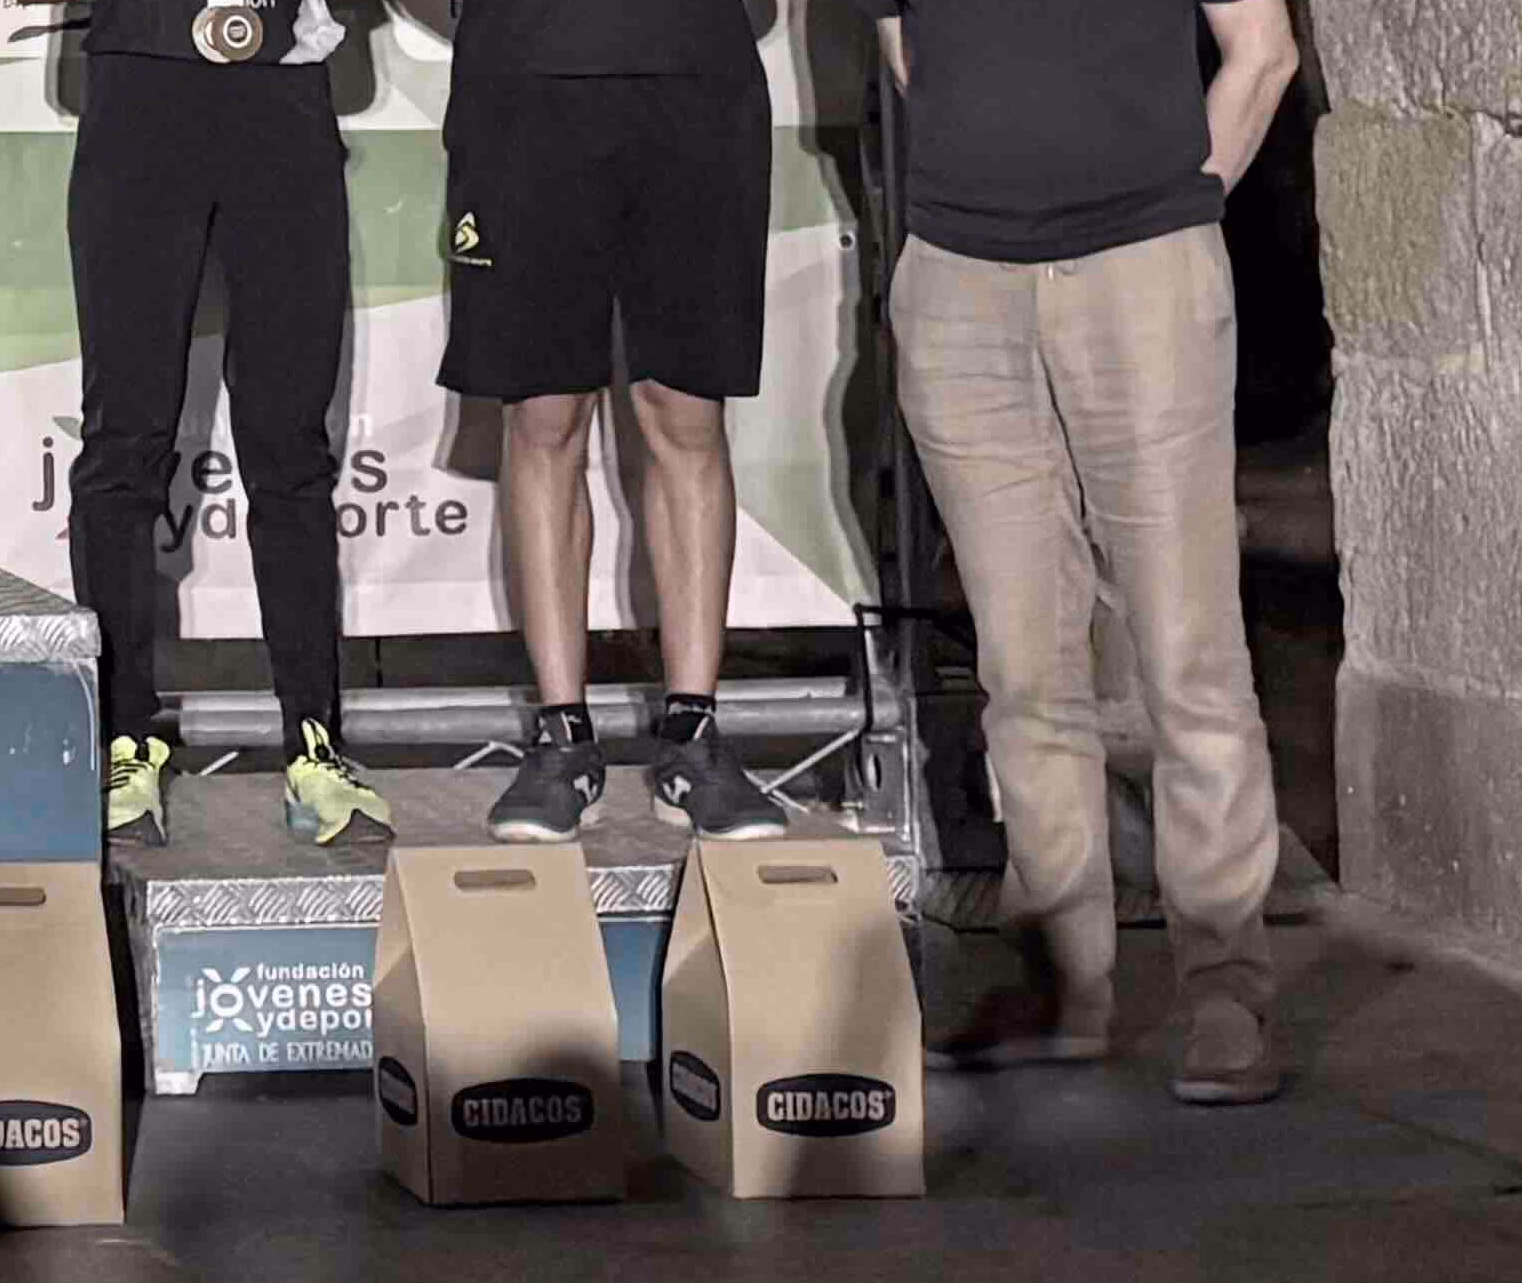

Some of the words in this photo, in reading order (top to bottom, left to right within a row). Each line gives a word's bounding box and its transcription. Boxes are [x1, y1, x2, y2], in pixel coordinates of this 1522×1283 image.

[160, 492, 469, 553] ydorte
[257, 962, 364, 980] fundación
[257, 1008, 373, 1037] ydepo
[259, 1042, 279, 1062] DE
[287, 1040, 373, 1061] EXTREMAD
[463, 1095, 582, 1130] CIDACOS
[767, 1088, 887, 1122] CIDACOS
